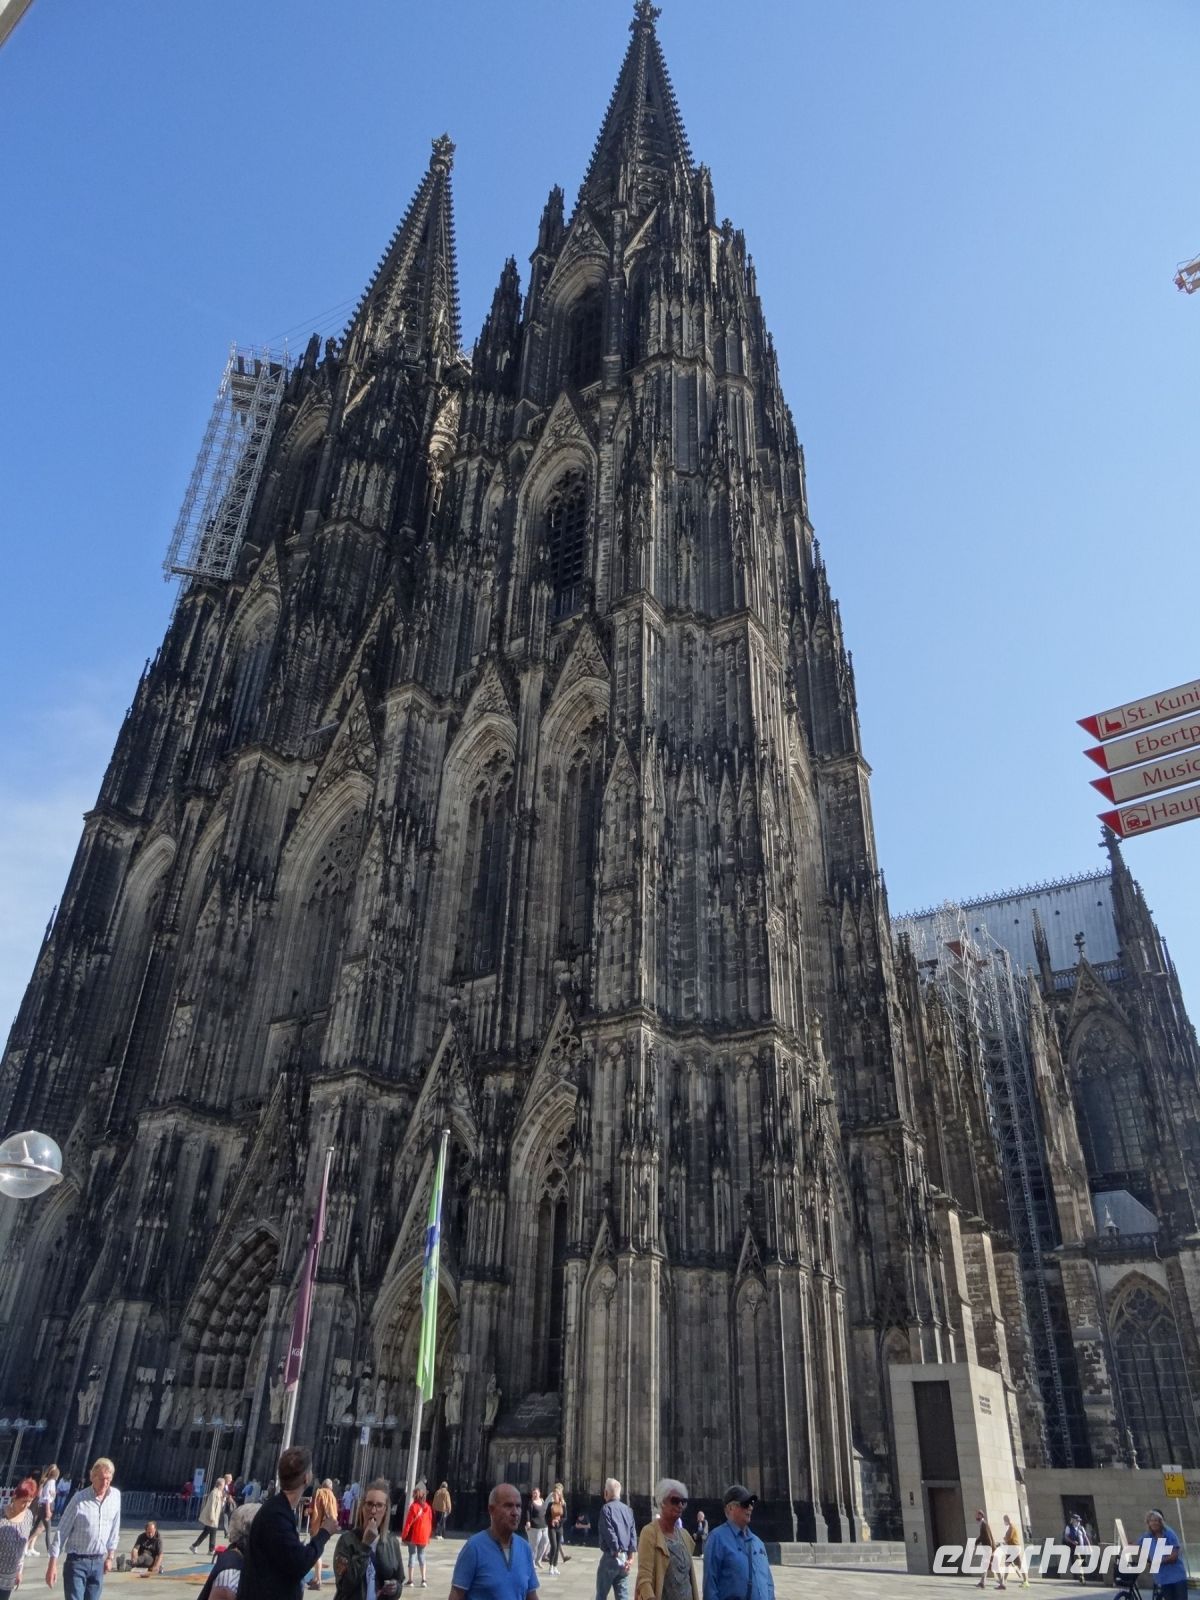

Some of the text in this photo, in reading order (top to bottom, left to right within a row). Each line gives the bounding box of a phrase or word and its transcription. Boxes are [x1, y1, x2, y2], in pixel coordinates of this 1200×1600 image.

[1126, 686, 1200, 724] St. Kuni
[1135, 725, 1200, 755] Ebertp
[1142, 759, 1200, 787] Music
